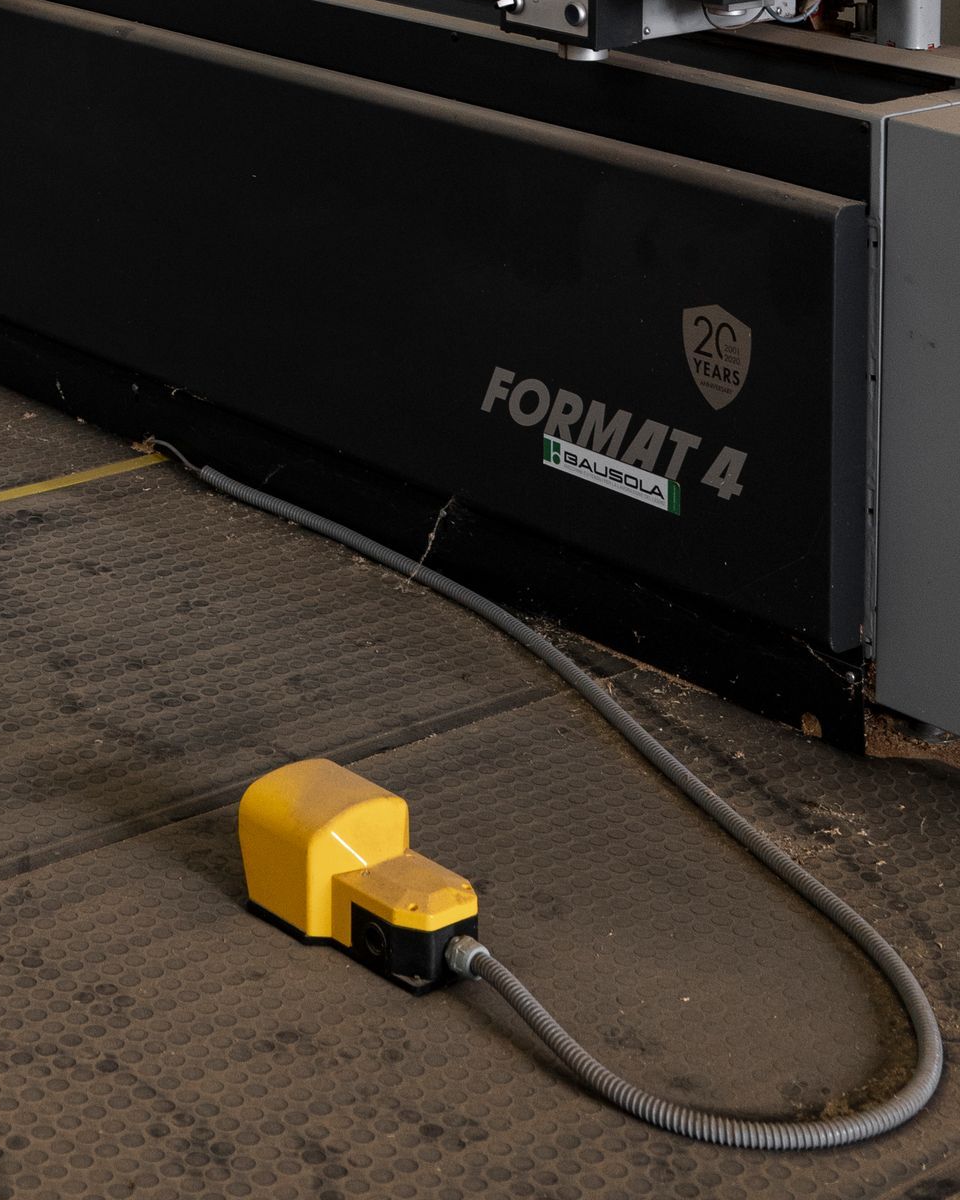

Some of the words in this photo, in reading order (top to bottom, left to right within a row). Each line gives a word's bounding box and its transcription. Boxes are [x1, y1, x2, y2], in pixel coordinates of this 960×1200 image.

[693, 315, 737, 360] 20
[693, 358, 740, 386] YEARS
[480, 366, 702, 481] FORMAT
[700, 445, 748, 500] 4
[563, 451, 665, 500] BAUSOLA
